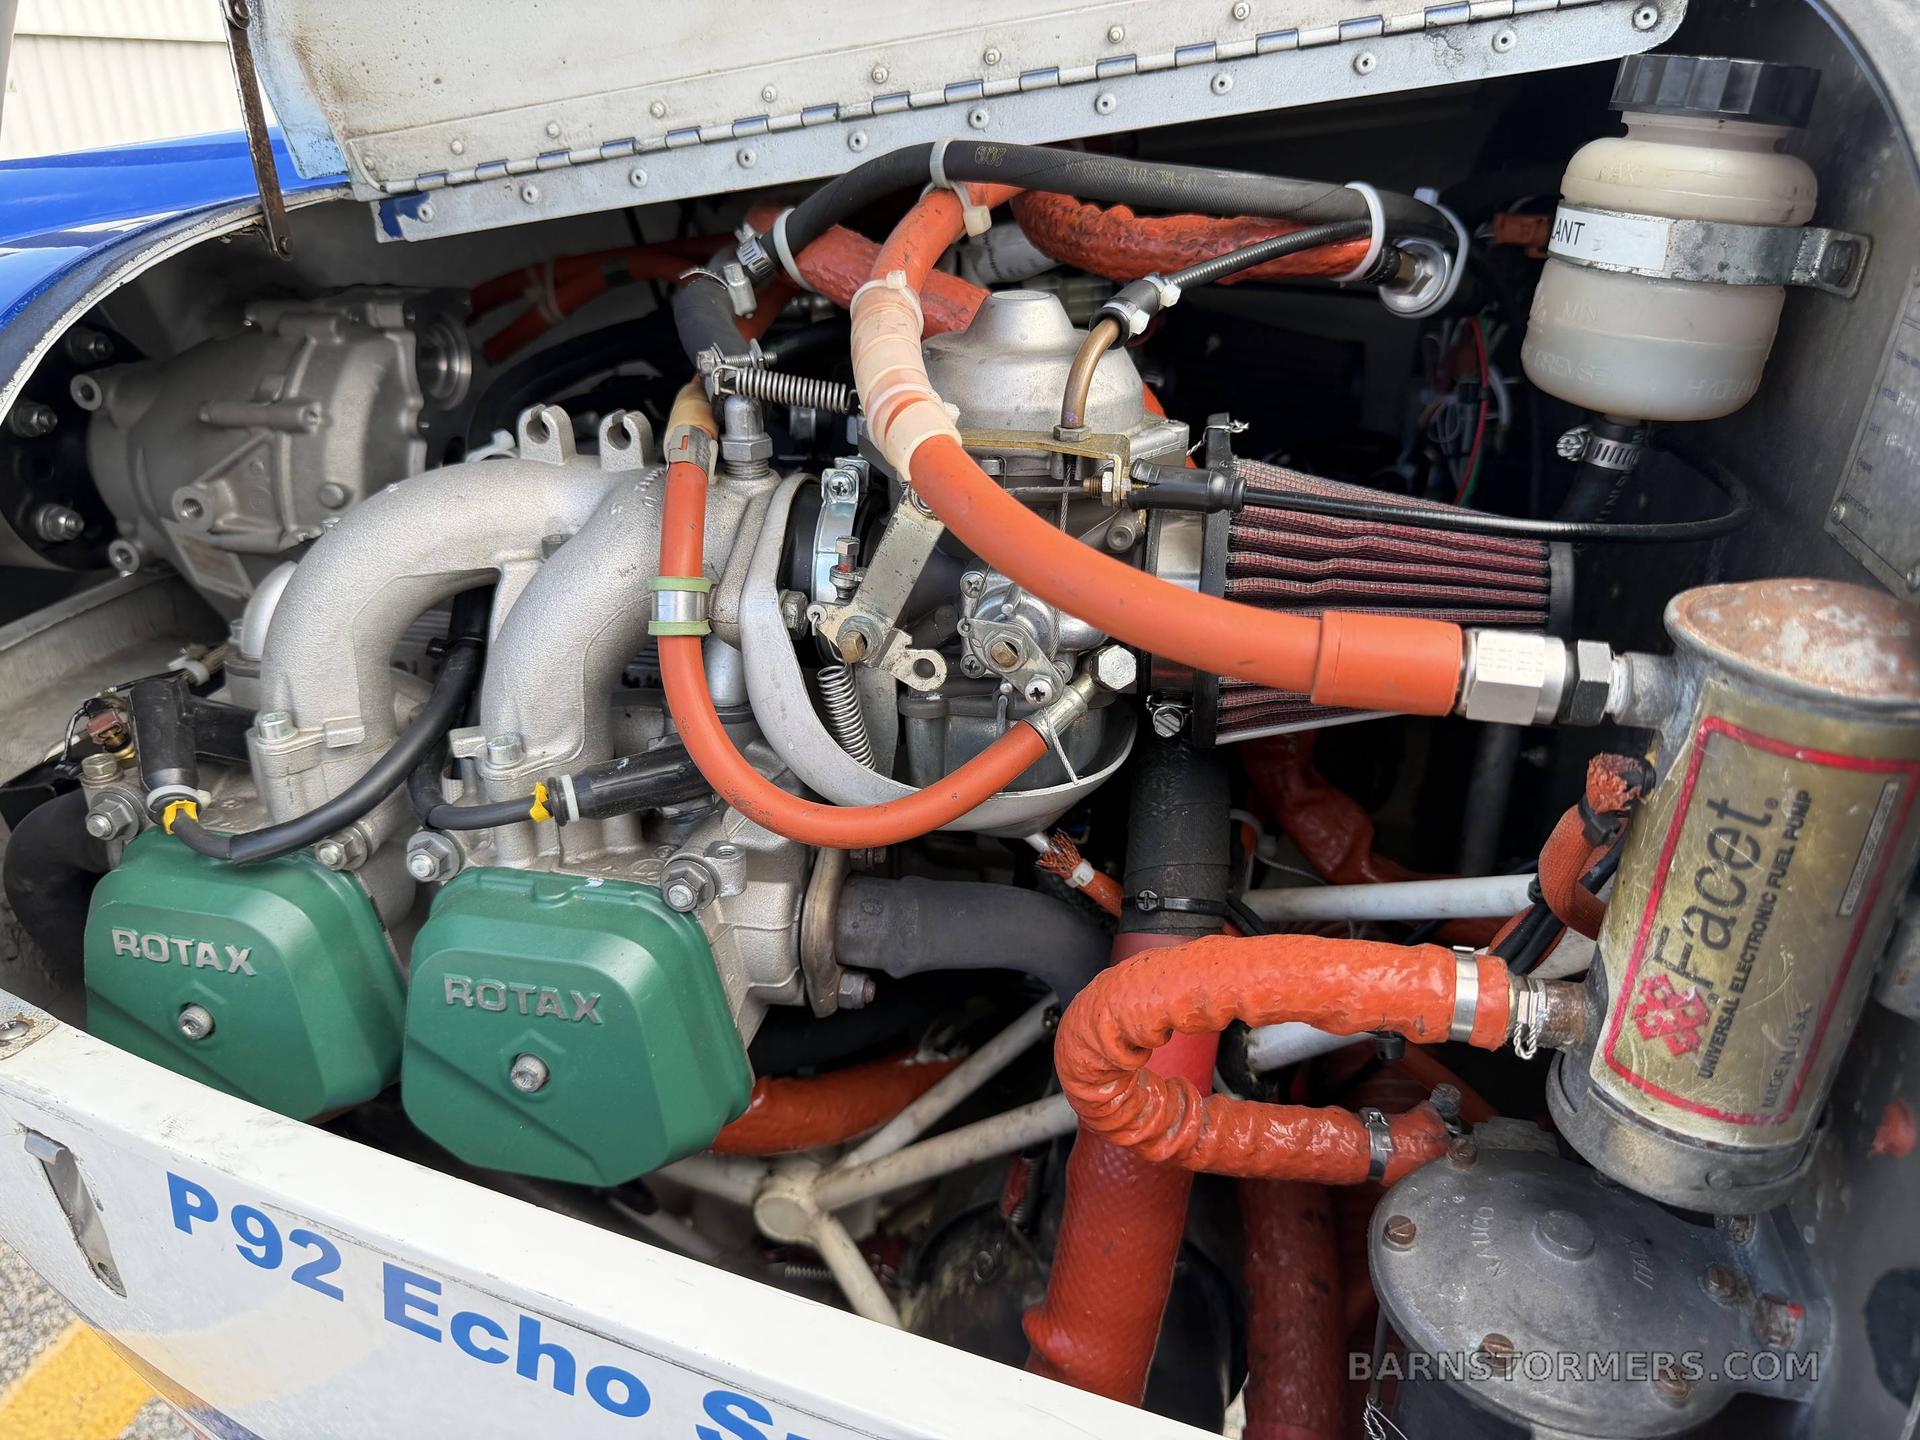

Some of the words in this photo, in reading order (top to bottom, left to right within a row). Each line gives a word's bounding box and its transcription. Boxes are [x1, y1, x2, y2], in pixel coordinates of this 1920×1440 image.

[111, 928, 258, 977] ROTAX
[1698, 997, 1740, 1079] UNIVERSAL
[1729, 891, 1778, 994] ELECTRONIC
[1766, 846, 1796, 889] FUEL
[1783, 789, 1813, 842] PUMP
[443, 973, 604, 1025] ROTAX
[383, 1262, 651, 1417] Echo
